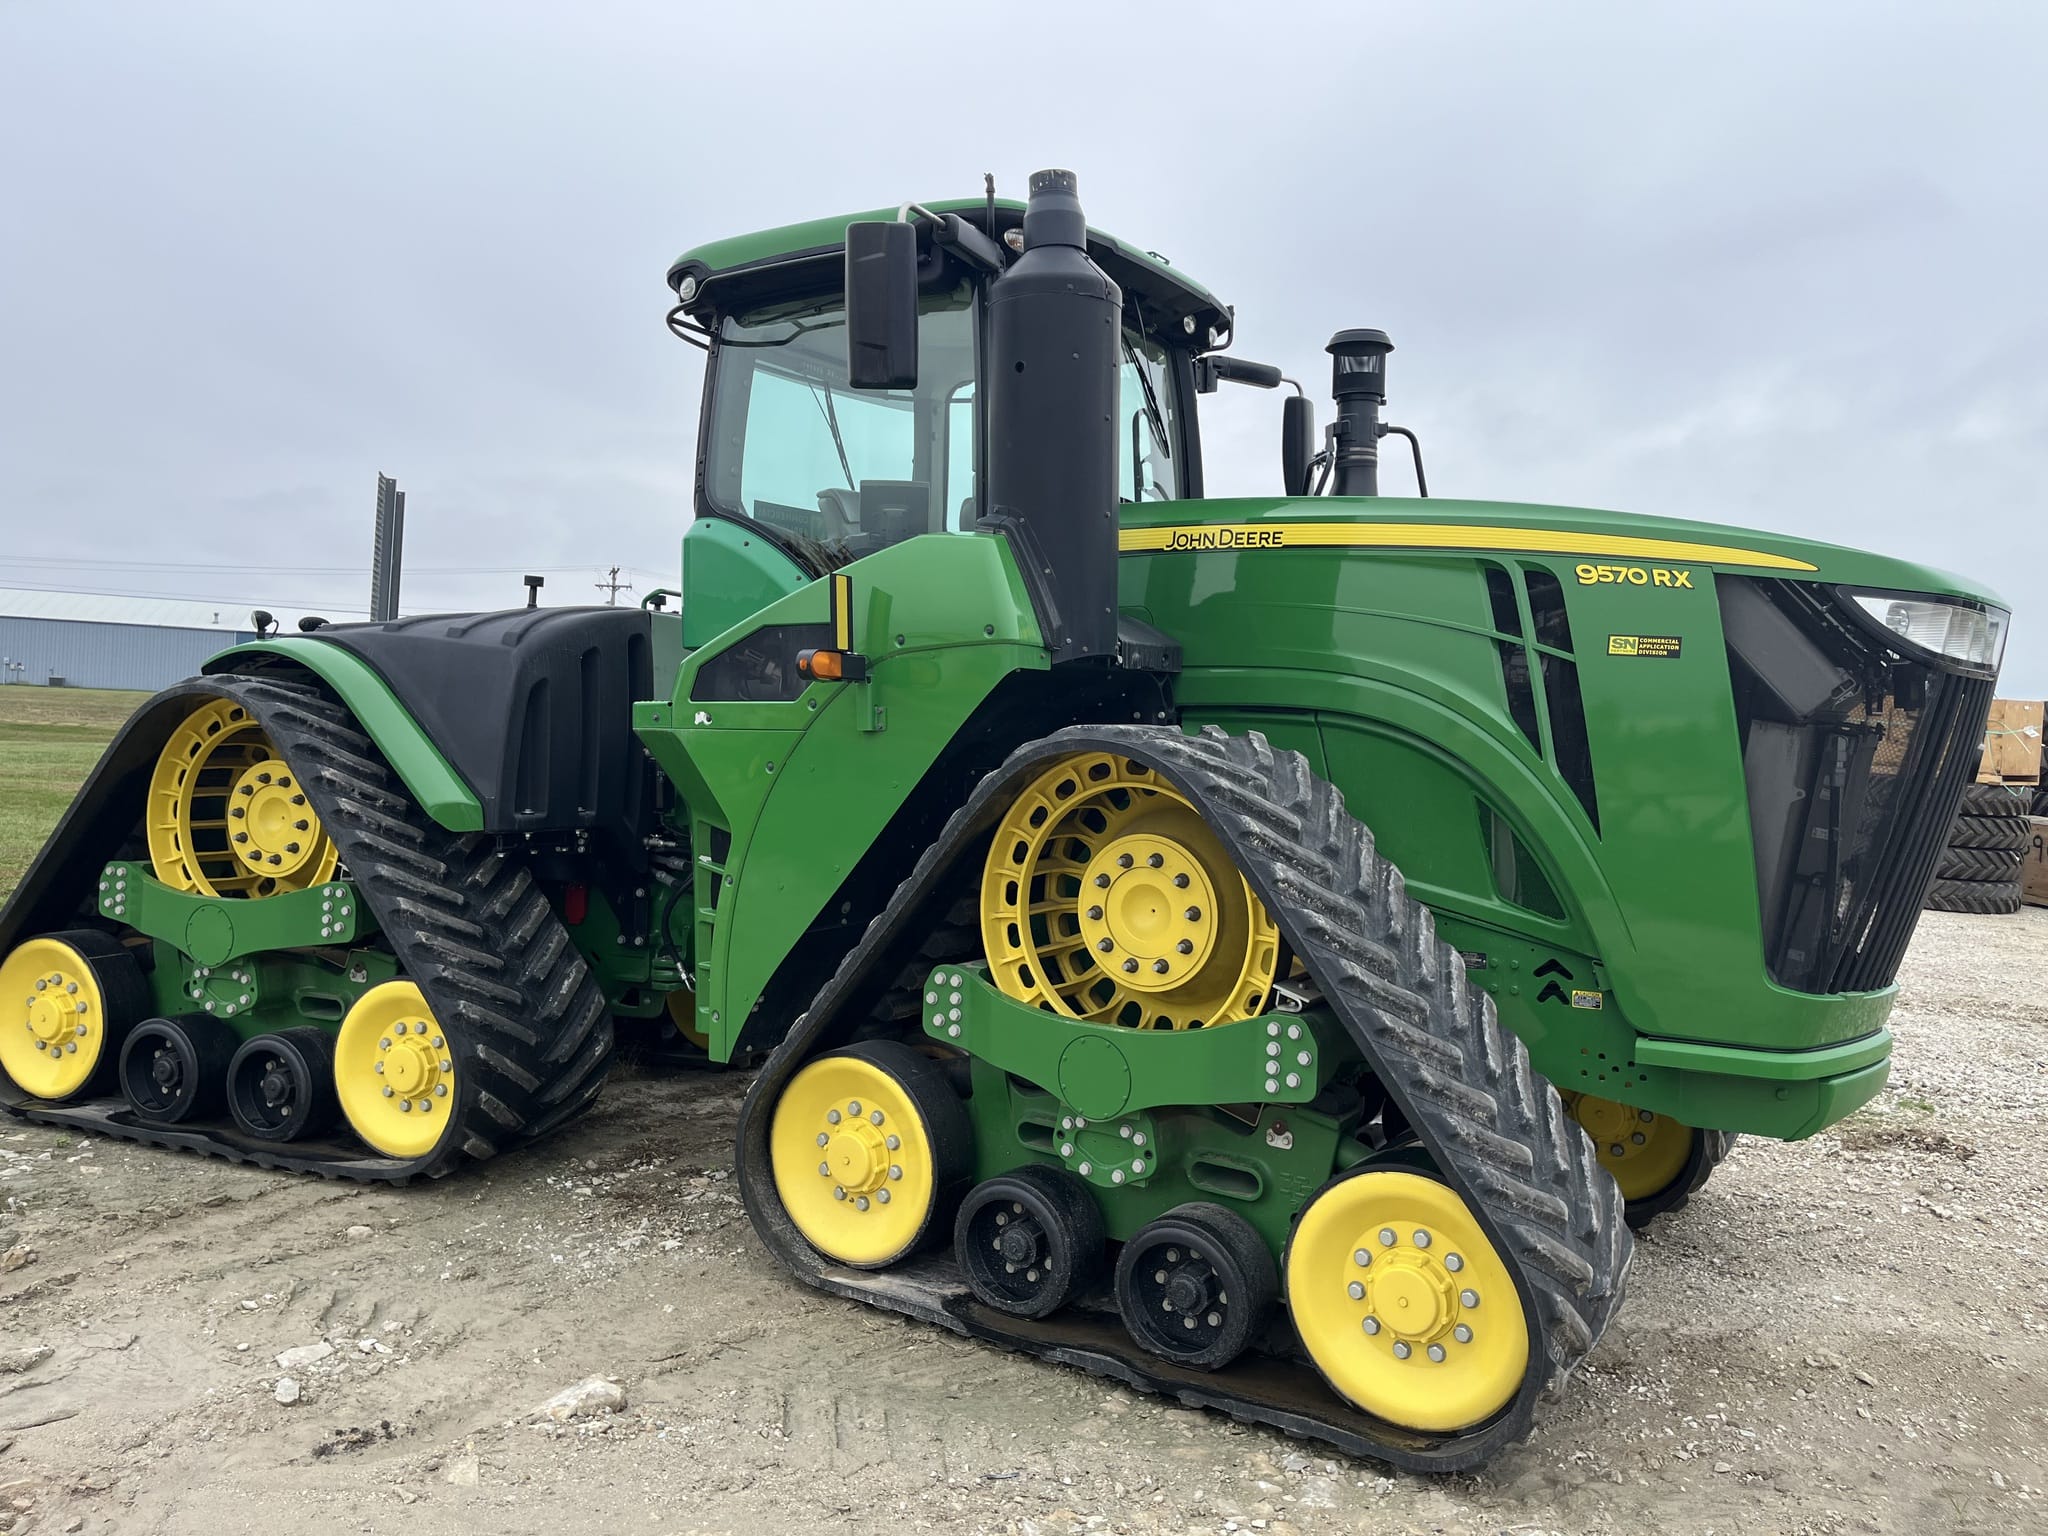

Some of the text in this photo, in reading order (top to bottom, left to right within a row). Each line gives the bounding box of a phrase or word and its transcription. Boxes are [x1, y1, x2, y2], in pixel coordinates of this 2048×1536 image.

[1165, 529, 1284, 548] JOHN DEERE
[1575, 564, 1695, 589] 9570 RX
[1611, 638, 1637, 649] SN
